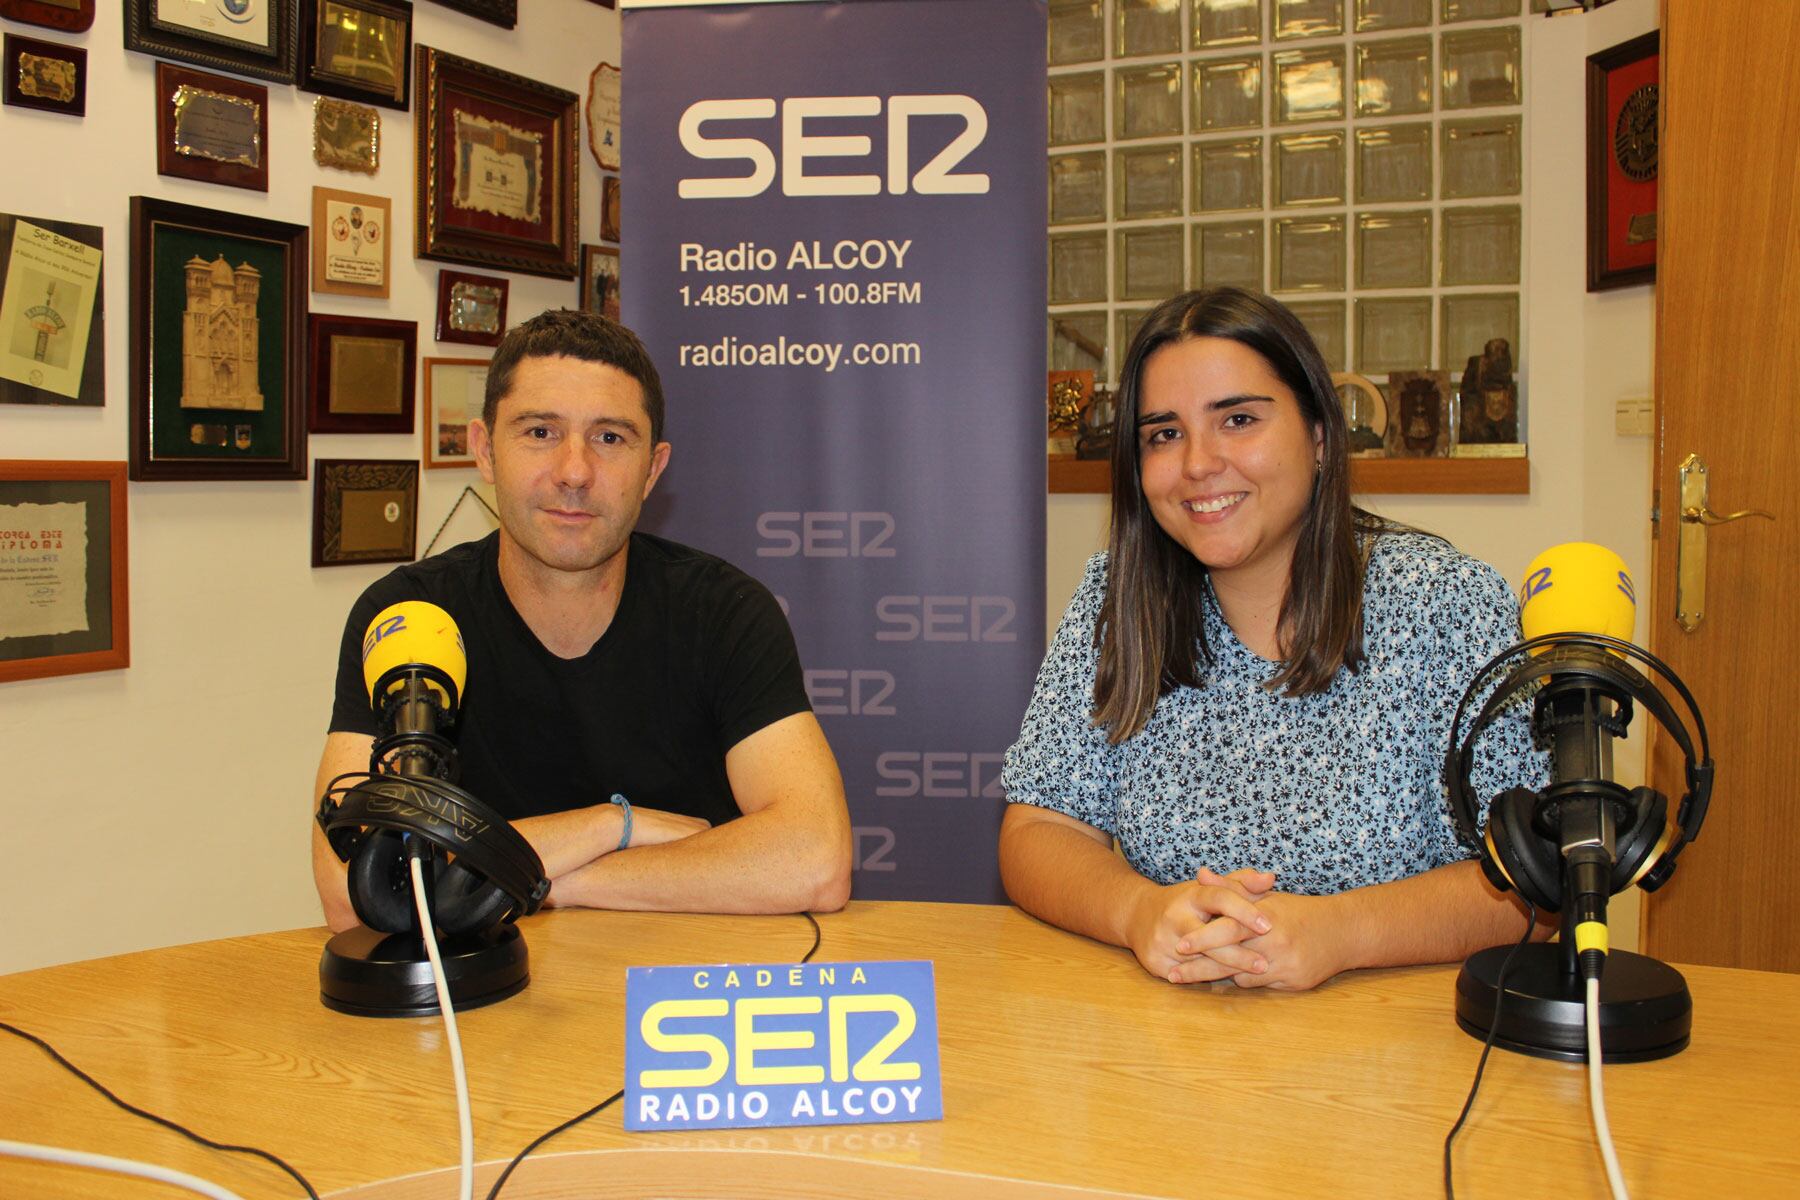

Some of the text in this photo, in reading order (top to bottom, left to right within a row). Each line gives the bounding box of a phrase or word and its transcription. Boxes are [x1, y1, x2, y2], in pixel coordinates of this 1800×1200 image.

[679, 95, 990, 199] SER
[33, 228, 51, 241] Ser
[680, 239, 912, 272] Radio ALCOY
[814, 282, 921, 305] 100.8FM
[680, 336, 921, 372] radioalcoy.com
[756, 511, 897, 558] SER
[875, 596, 1017, 642] SER
[804, 670, 897, 715] ER
[693, 966, 867, 990] CADENA
[639, 995, 921, 1089] SER
[640, 1086, 923, 1123] RADIO ALCOY
